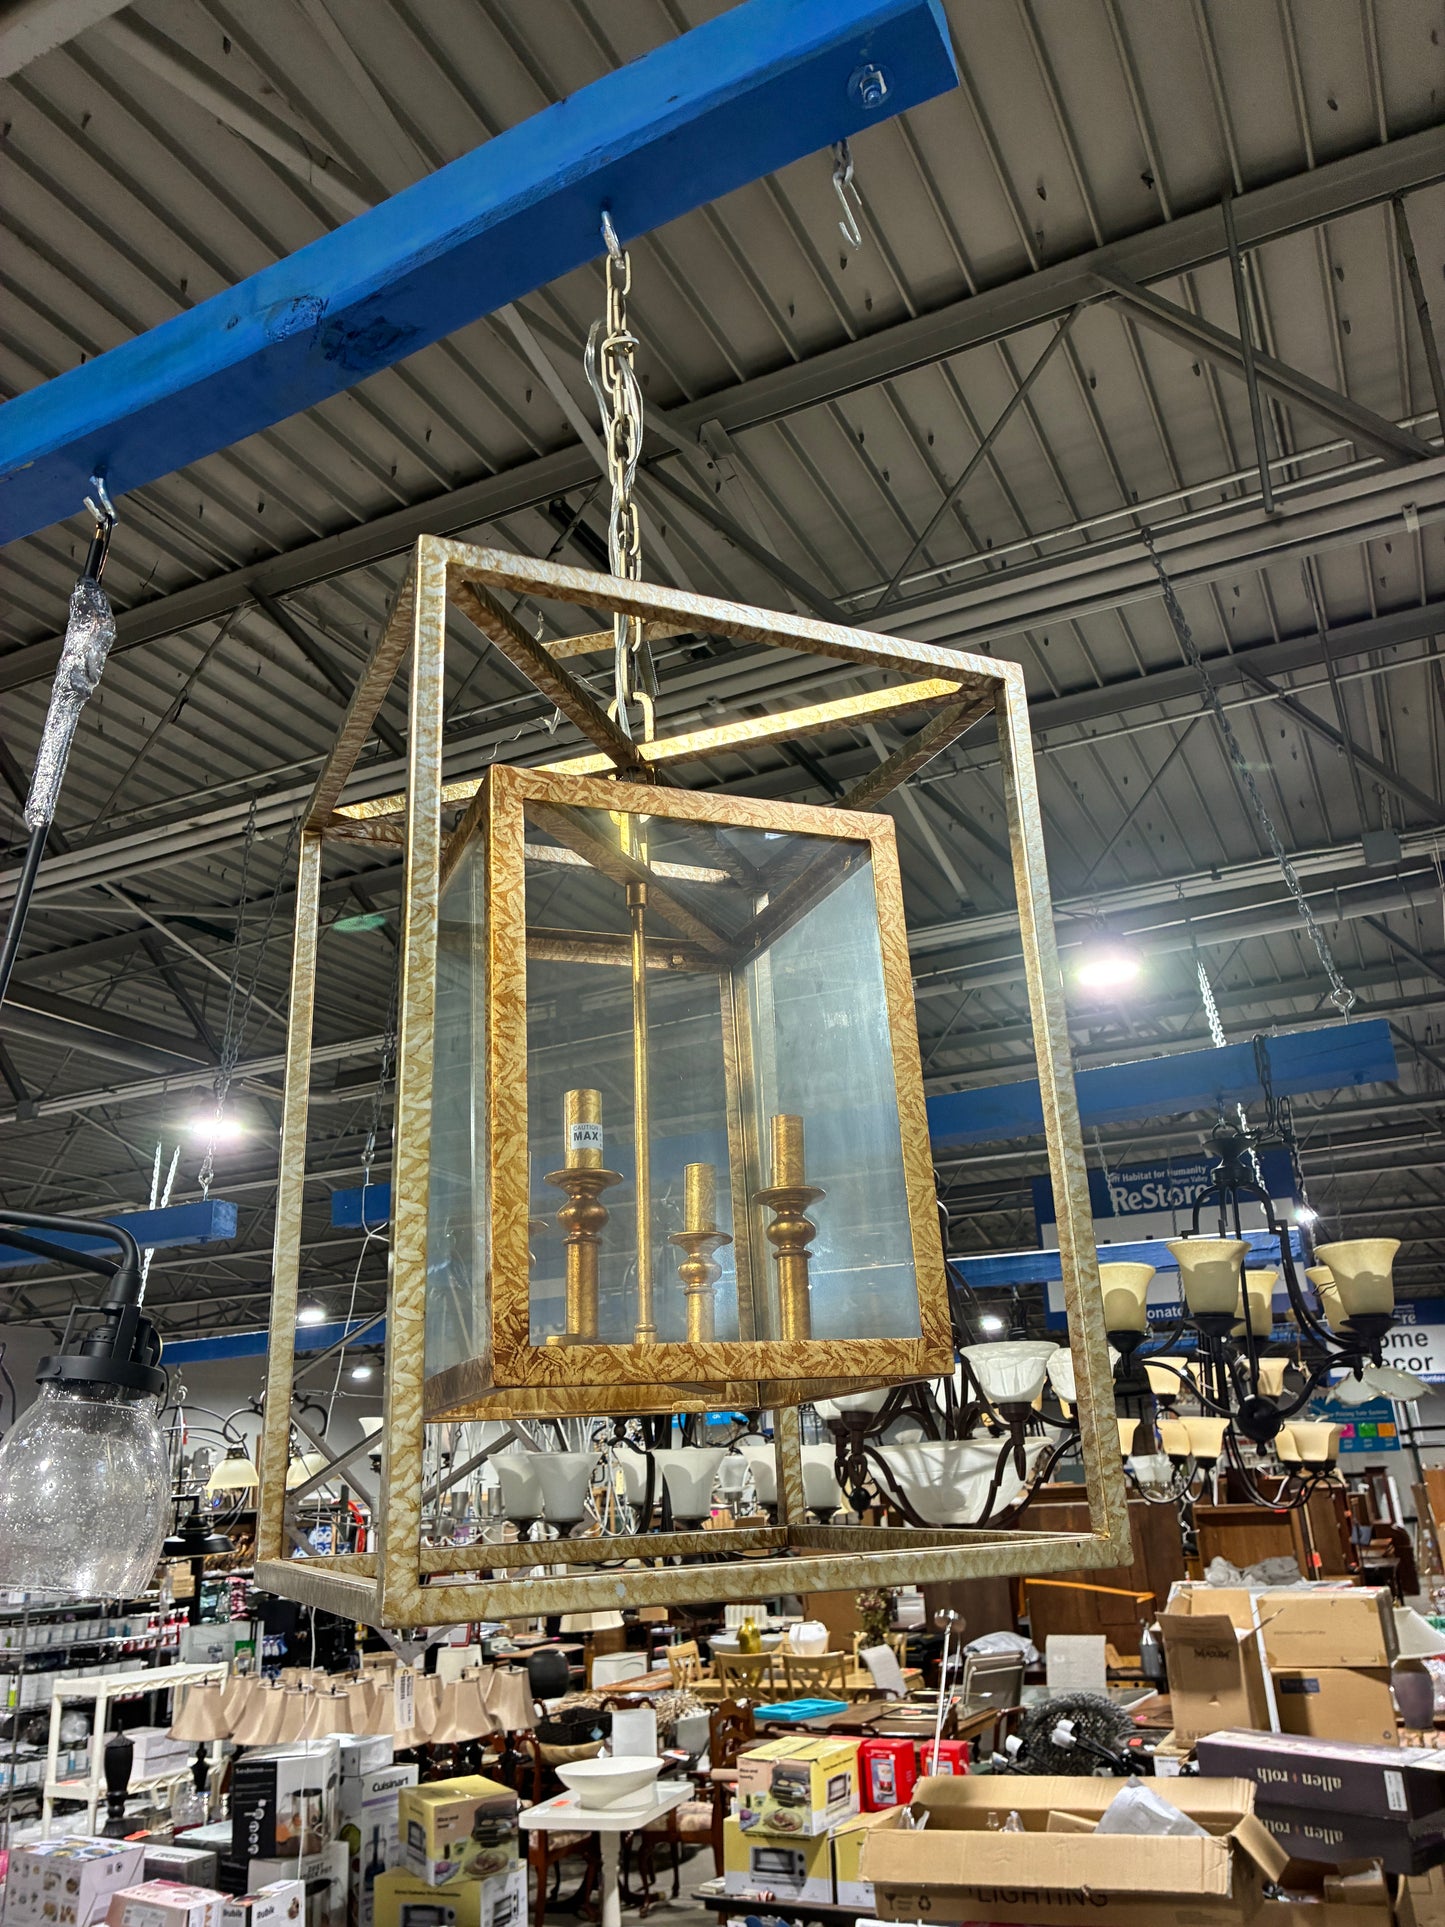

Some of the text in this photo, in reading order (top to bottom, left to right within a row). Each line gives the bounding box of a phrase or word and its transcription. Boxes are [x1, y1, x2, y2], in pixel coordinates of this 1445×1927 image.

[573, 1131, 599, 1141] MAX
[1122, 1165, 1207, 1182] Habitat for Humanity
[1110, 1183, 1211, 1212] ReStore
[1380, 1332, 1429, 1349] ome
[372, 1776, 409, 1792] Cuisinart
[1256, 1767, 1289, 1784] roth
[1301, 1773, 1342, 1792] allen
[1303, 1825, 1344, 1845] allen
